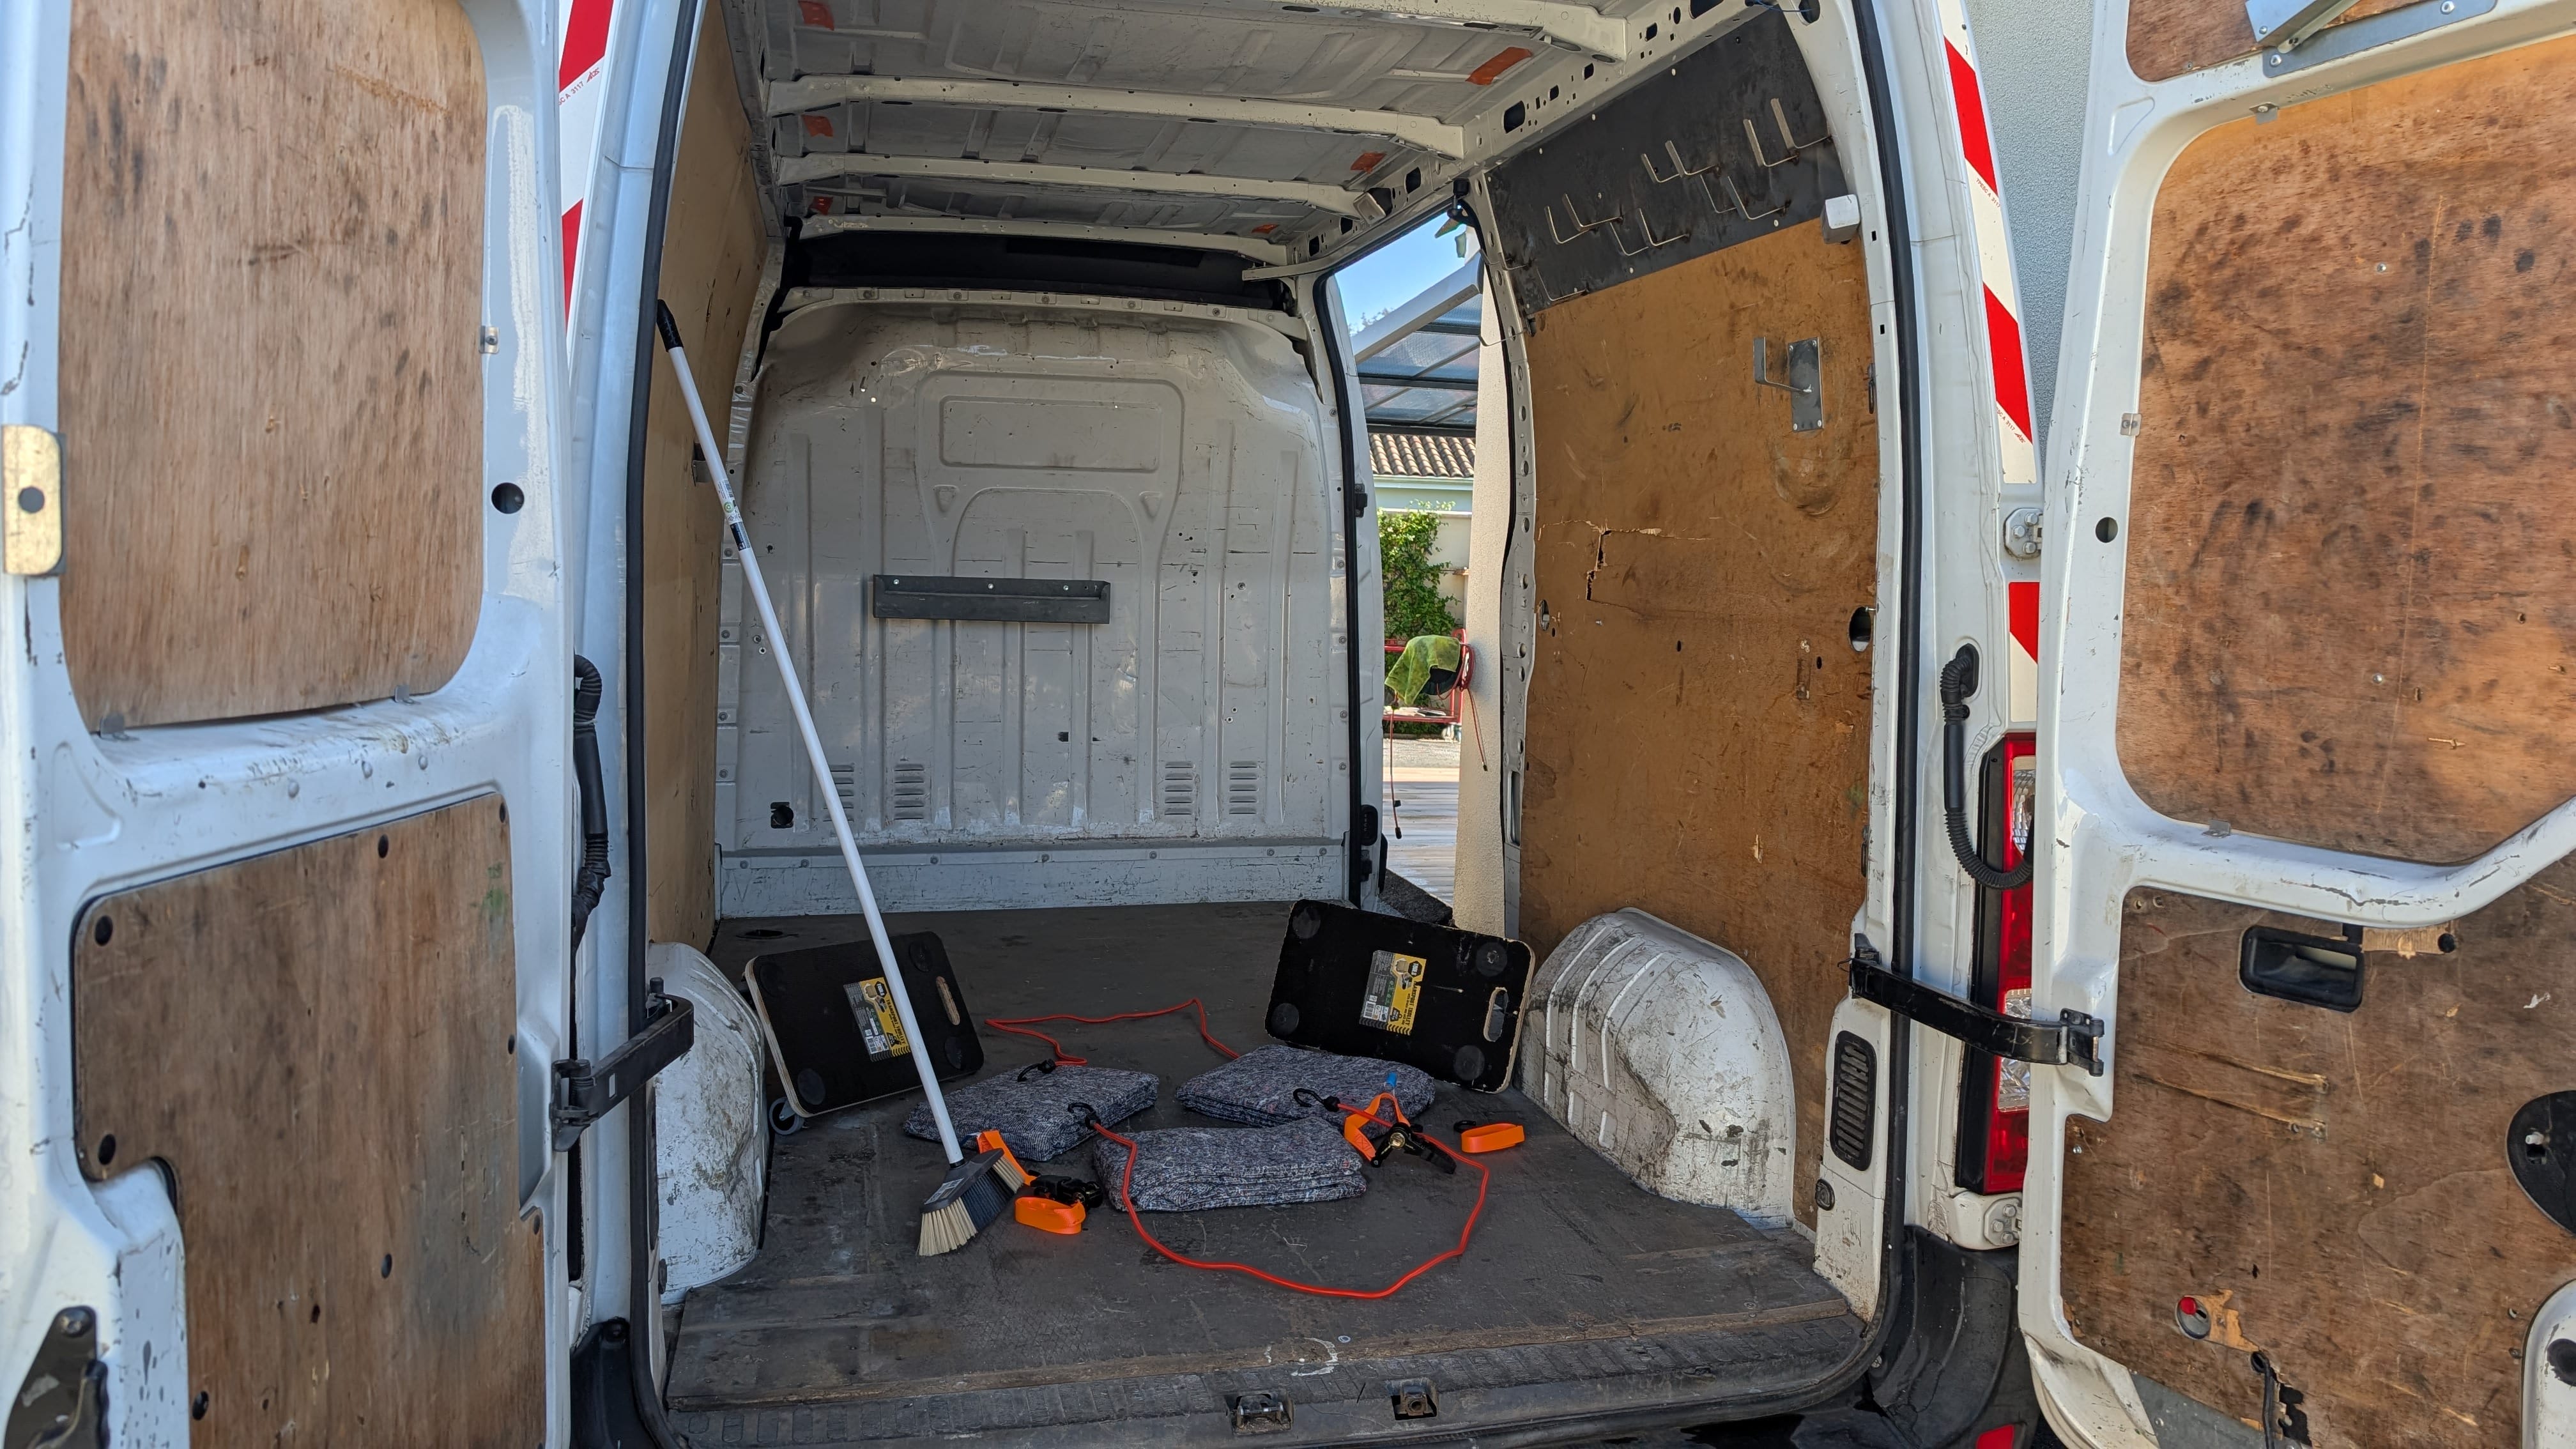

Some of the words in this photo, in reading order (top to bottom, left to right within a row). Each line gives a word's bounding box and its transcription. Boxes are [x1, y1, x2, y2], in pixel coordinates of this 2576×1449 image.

[571, 80, 584, 94] 3117
[1975, 178, 1989, 193] TPESC
[1991, 197, 2000, 208] 3117
[2005, 420, 2015, 431] 3117
